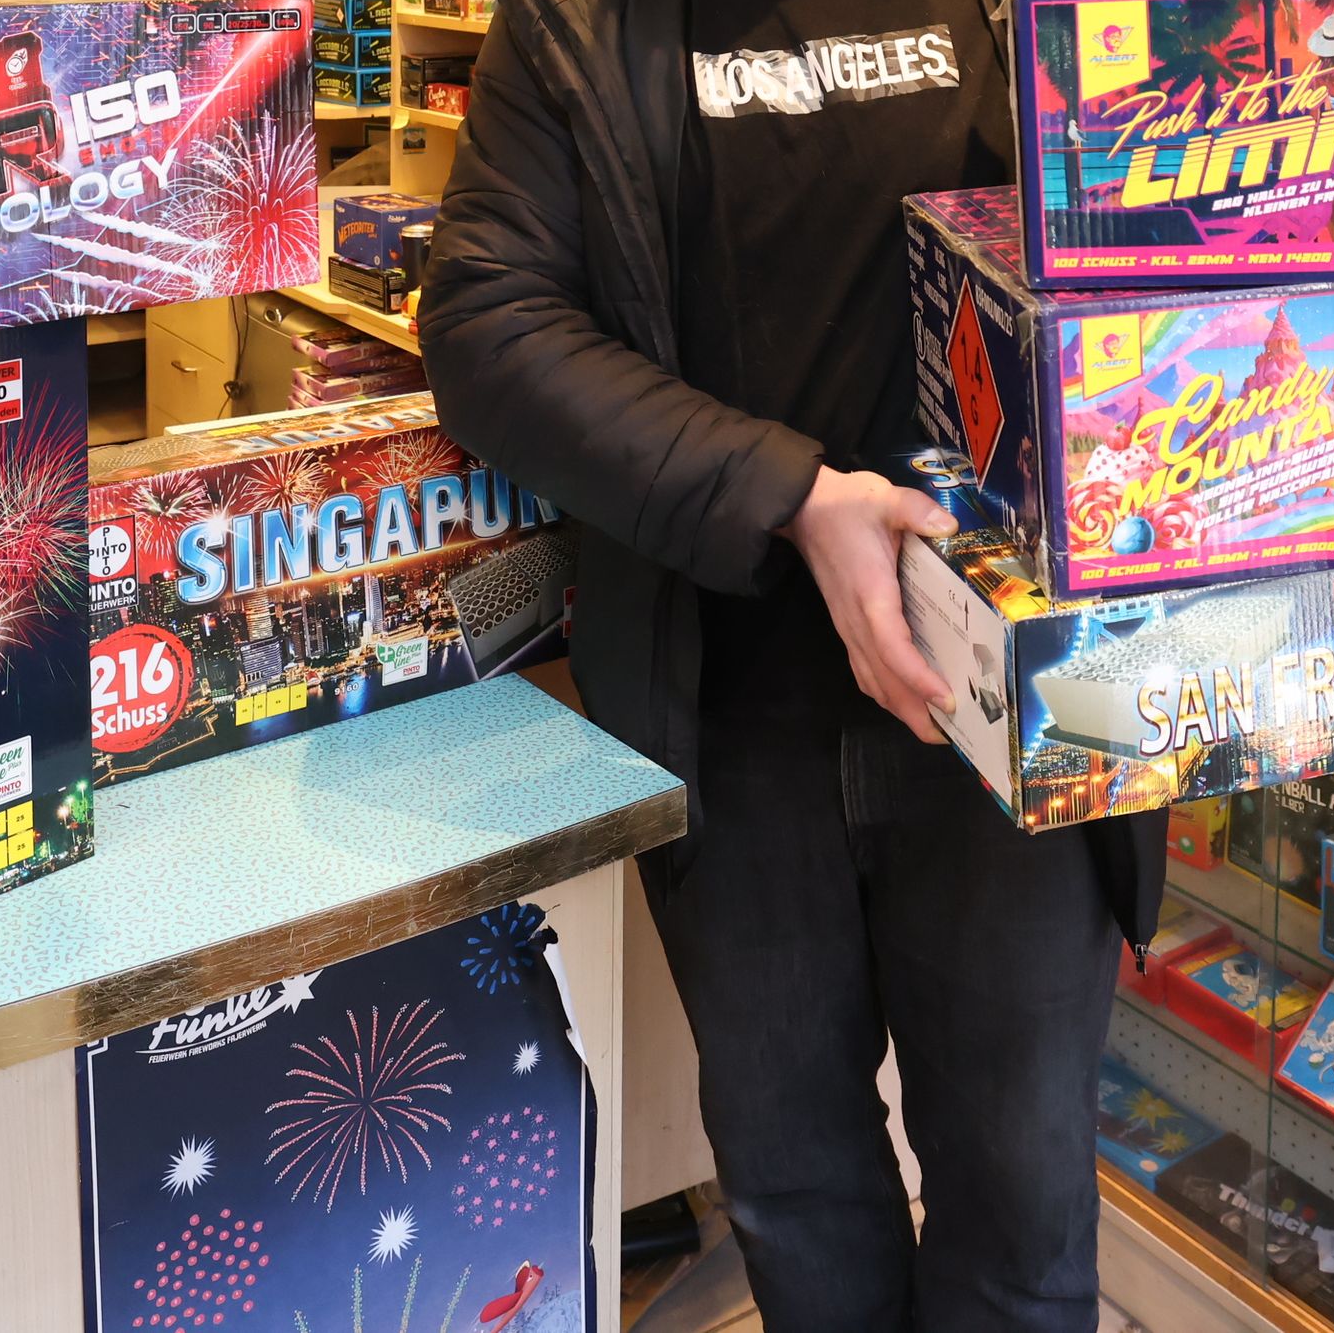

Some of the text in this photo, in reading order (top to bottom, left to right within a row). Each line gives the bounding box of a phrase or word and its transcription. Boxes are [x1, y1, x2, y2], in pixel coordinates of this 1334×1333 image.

[704, 32, 949, 107] LOS ANGELES
[69, 70, 182, 146] 150
[1100, 83, 1206, 161] Push
[1247, 186, 1297, 205] HALLO
[1081, 255, 1138, 268] SCHUSS
[1107, 562, 1162, 578] SCHUSS
[92, 641, 175, 699] 216
[92, 700, 168, 738] Schuss
[1137, 664, 1256, 757] SAN
[149, 1038, 227, 1064] FEUERWERK FIREWORKS
